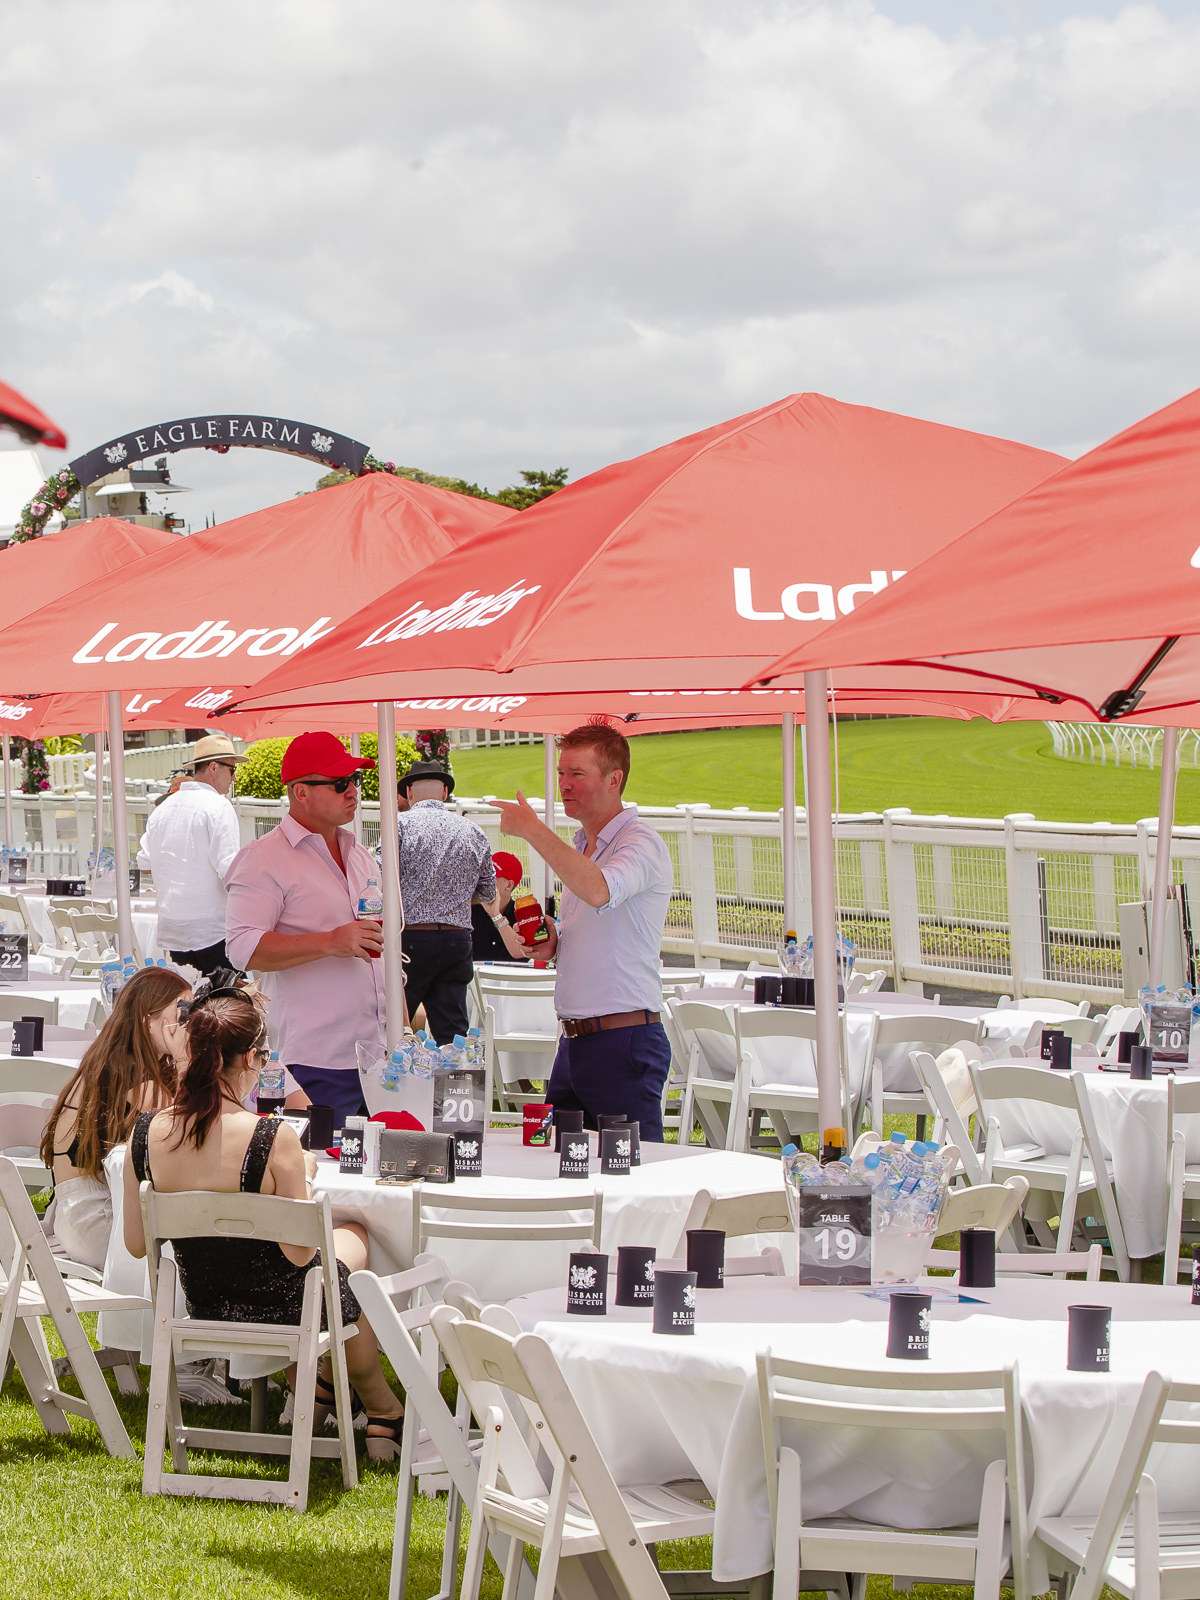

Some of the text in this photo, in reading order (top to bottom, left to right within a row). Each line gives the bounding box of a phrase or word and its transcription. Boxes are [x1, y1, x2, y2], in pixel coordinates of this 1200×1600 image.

[134, 418, 302, 454] EAGLE FARM
[14, 868, 21, 878] 4
[0, 952, 22, 969] 22
[1158, 1029, 1182, 1049] 10
[448, 1087, 470, 1095] TABLE
[441, 1098, 474, 1123] 20
[820, 1214, 851, 1223] TABLE
[814, 1228, 857, 1260] 19
